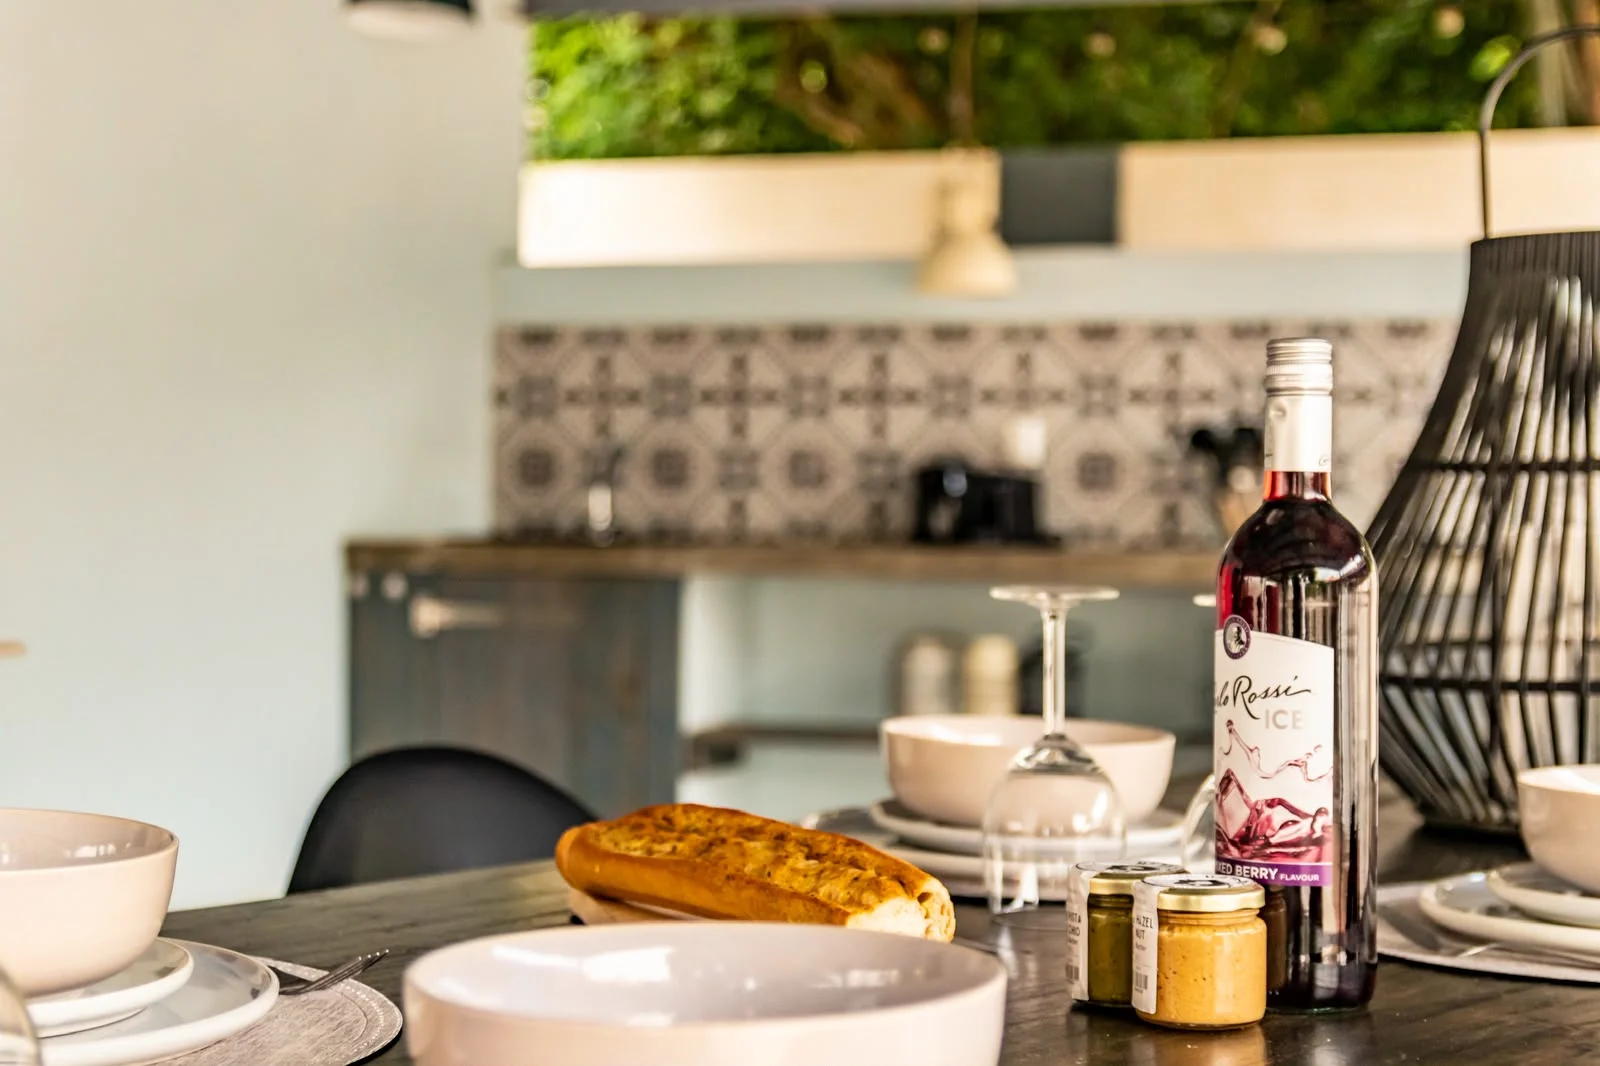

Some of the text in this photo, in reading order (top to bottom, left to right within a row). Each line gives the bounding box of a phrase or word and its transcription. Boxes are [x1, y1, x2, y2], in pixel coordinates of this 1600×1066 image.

[1232, 675, 1311, 720] Rossi
[1265, 709, 1304, 730] ICE
[1235, 864, 1279, 881] BERRY
[1280, 873, 1320, 882] FLAVOUR
